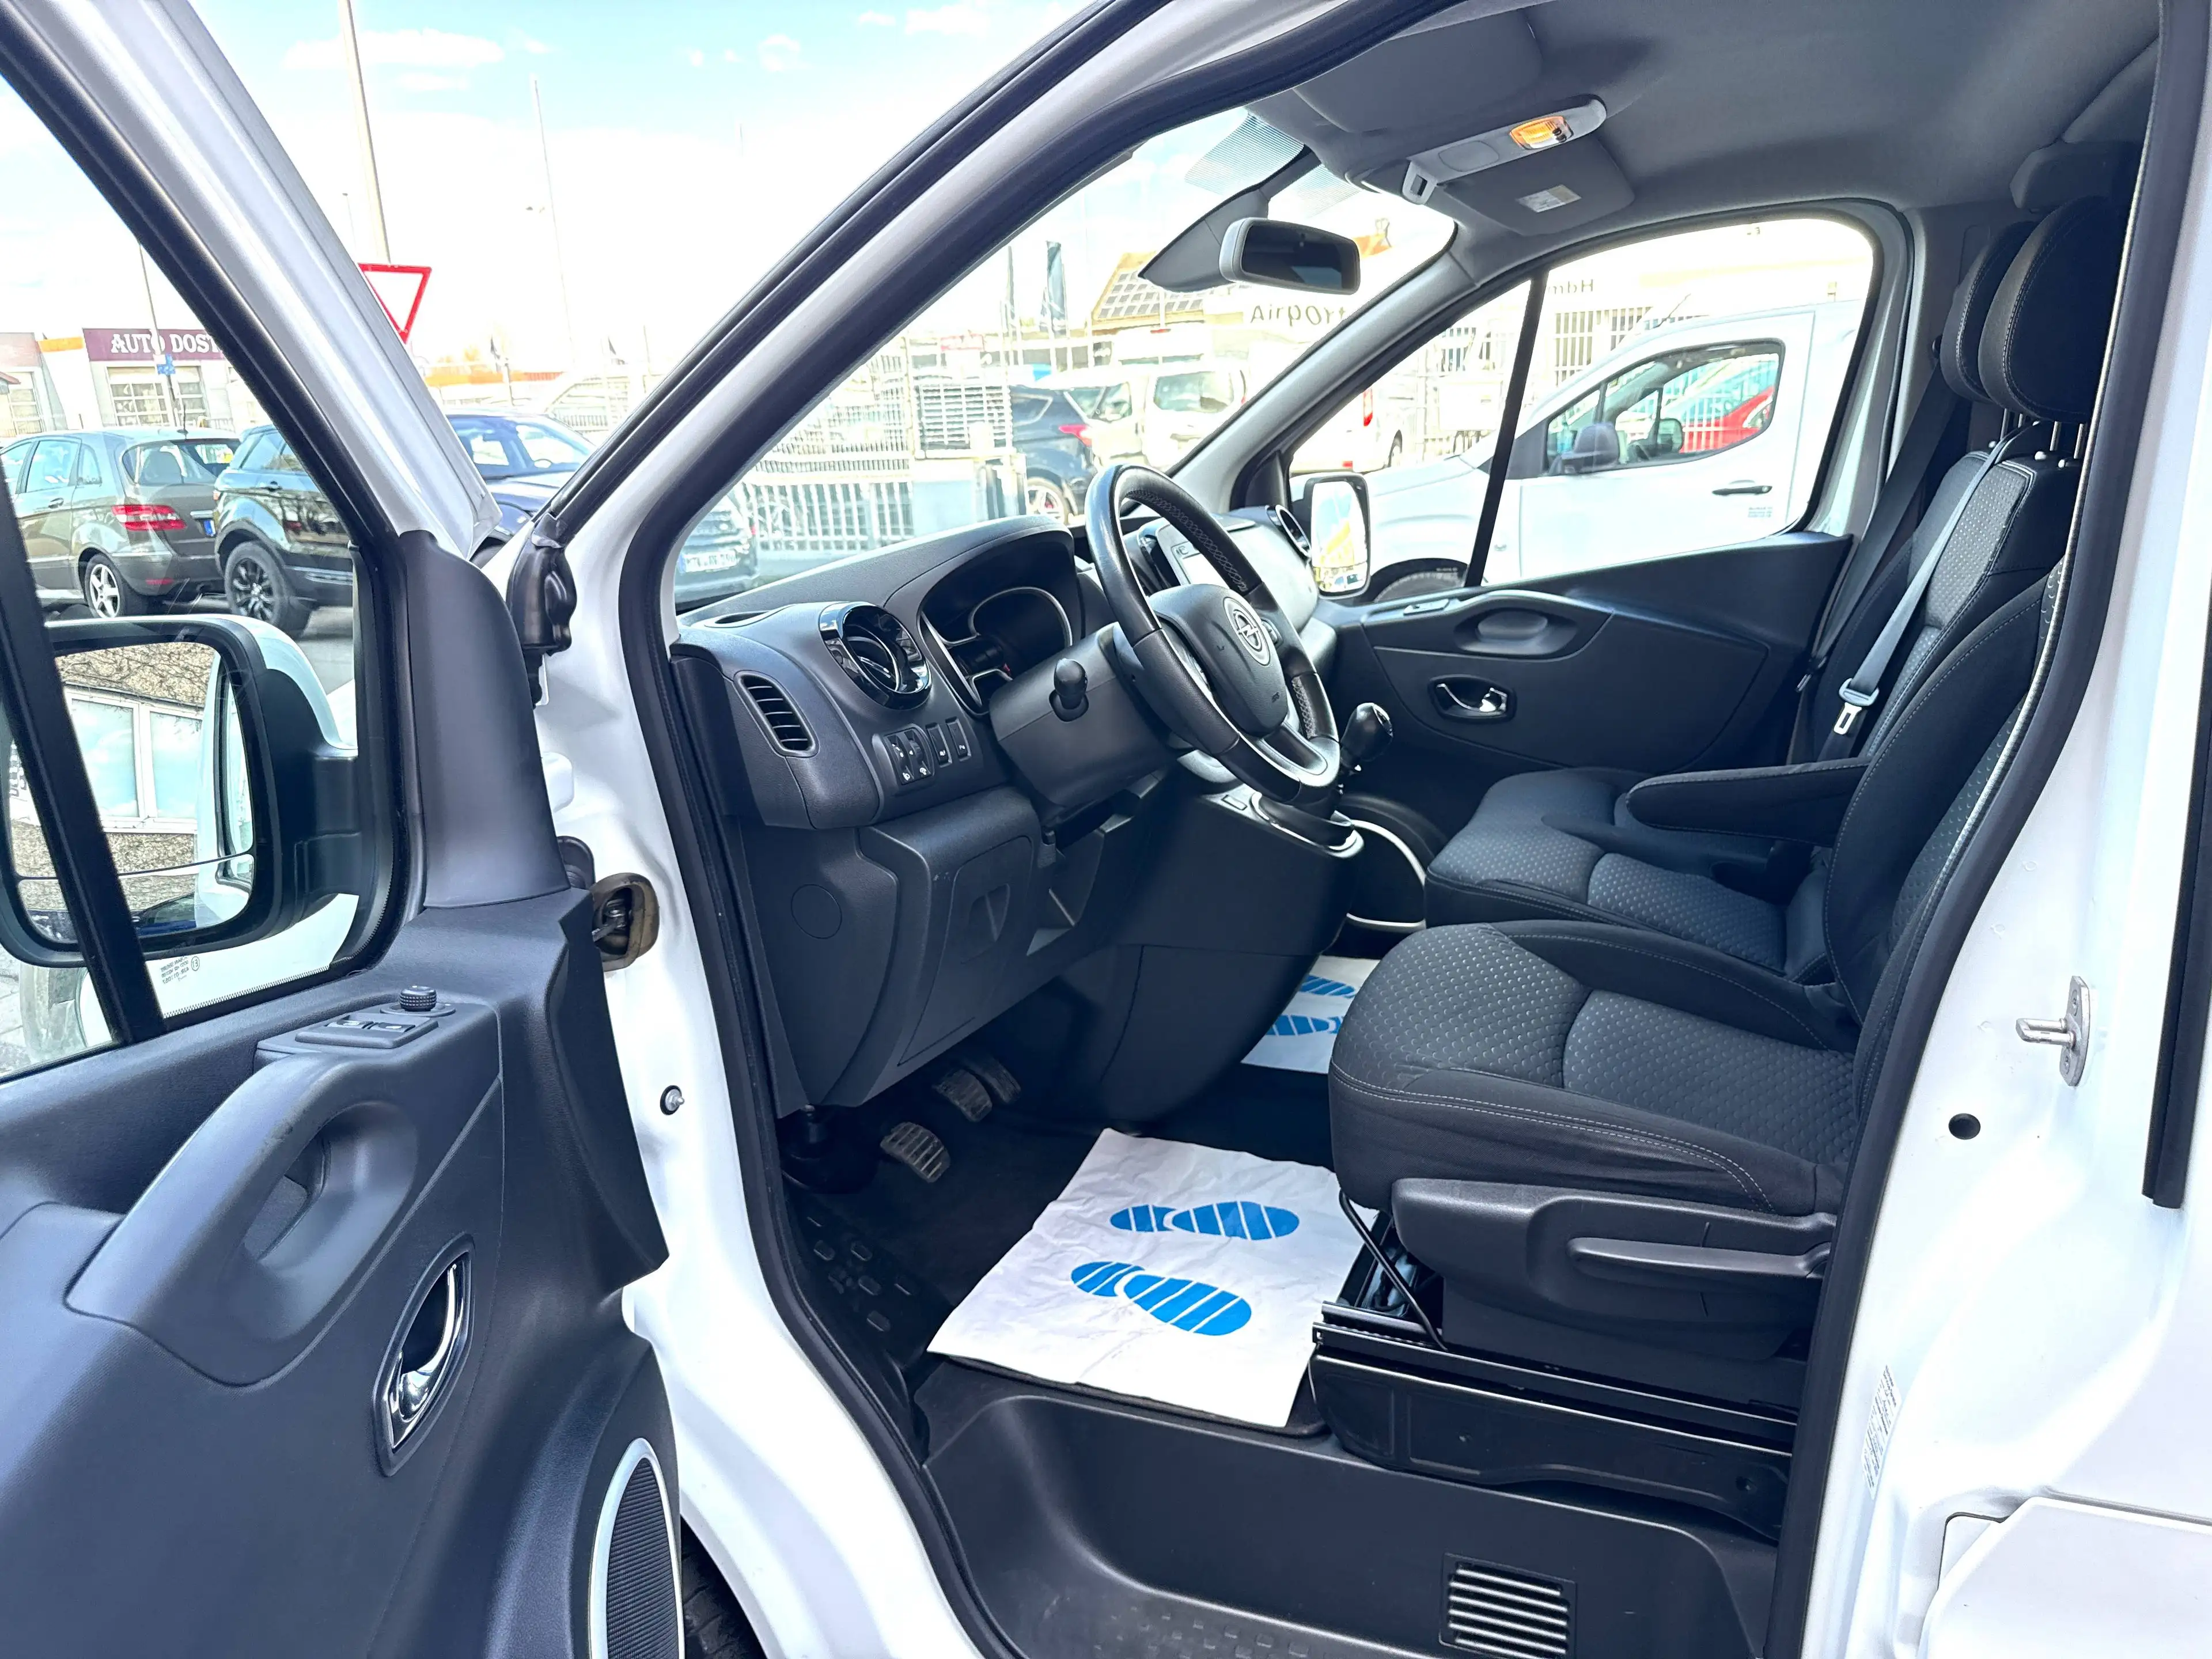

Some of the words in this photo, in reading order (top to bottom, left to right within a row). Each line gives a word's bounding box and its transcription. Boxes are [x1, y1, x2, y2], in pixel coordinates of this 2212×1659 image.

[1548, 279, 1593, 295] mbH
[1251, 305, 1346, 327] Airport
[111, 334, 165, 353] AUTO
